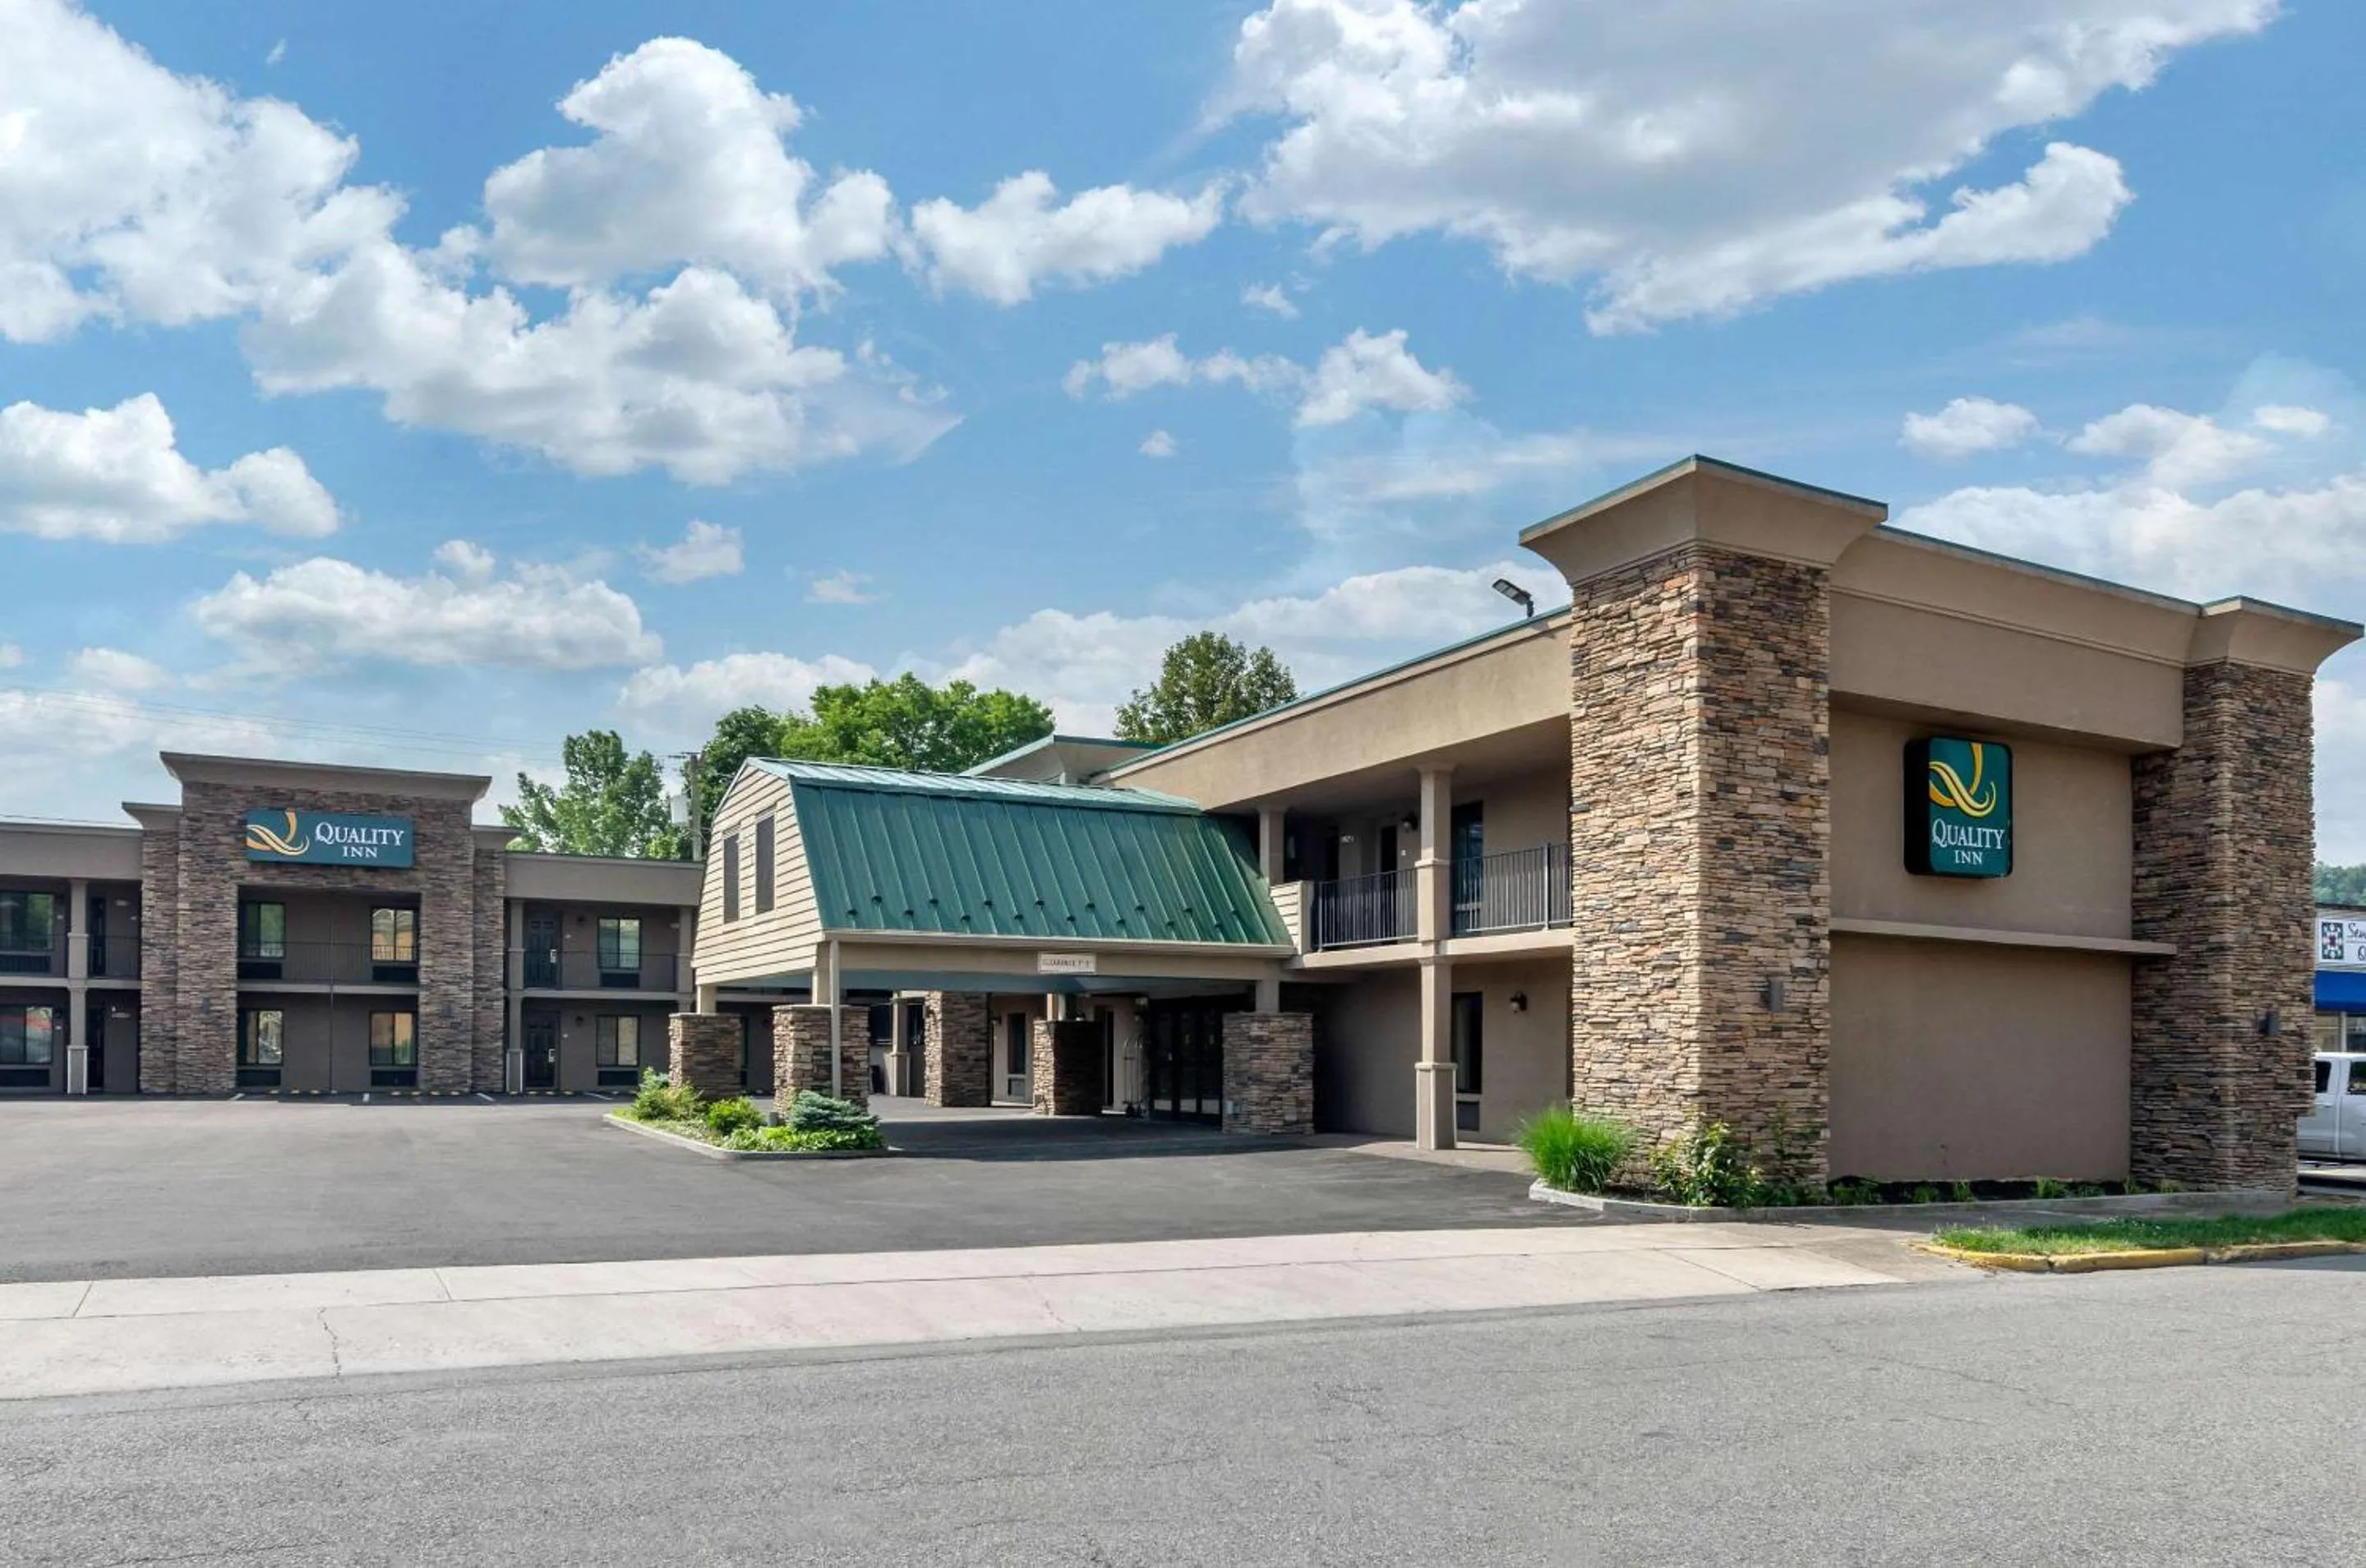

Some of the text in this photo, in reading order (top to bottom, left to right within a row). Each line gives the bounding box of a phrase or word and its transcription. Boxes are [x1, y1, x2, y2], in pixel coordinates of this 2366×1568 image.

[316, 822, 404, 846] QUALITY
[1932, 819, 2005, 849] QUALITY
[343, 846, 378, 858] INN
[1955, 850, 1982, 865] INN
